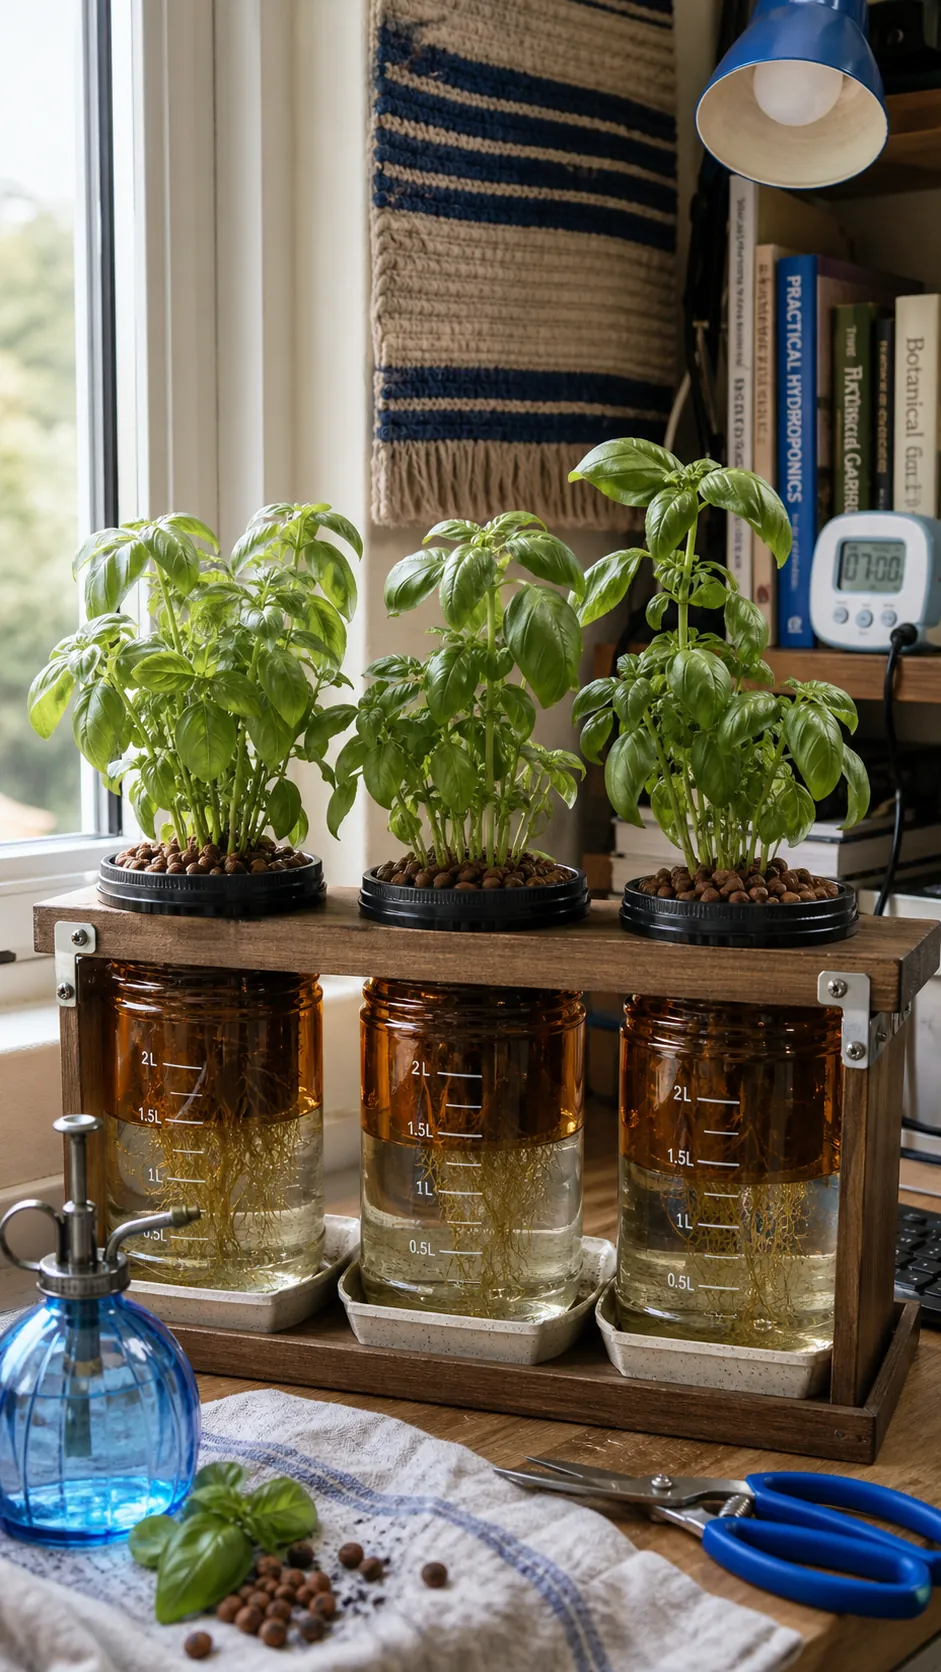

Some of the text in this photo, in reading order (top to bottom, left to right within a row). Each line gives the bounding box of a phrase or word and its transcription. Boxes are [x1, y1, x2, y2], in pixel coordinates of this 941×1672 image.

[786, 275, 802, 371] PRACTICAL
[905, 337, 925, 438] Botanical
[141, 1050, 157, 1067] 2L
[411, 1060, 430, 1077] 2L
[673, 1085, 692, 1102] 2L
[138, 1107, 162, 1124] 1.5L
[407, 1121, 434, 1138] 1.5L
[667, 1148, 694, 1167] 1.5L
[148, 1168, 163, 1183] 1L
[416, 1180, 433, 1196] 1L
[676, 1213, 693, 1230] 1L
[409, 1239, 436, 1257] 0.5L
[667, 1272, 695, 1291] 0.5L
